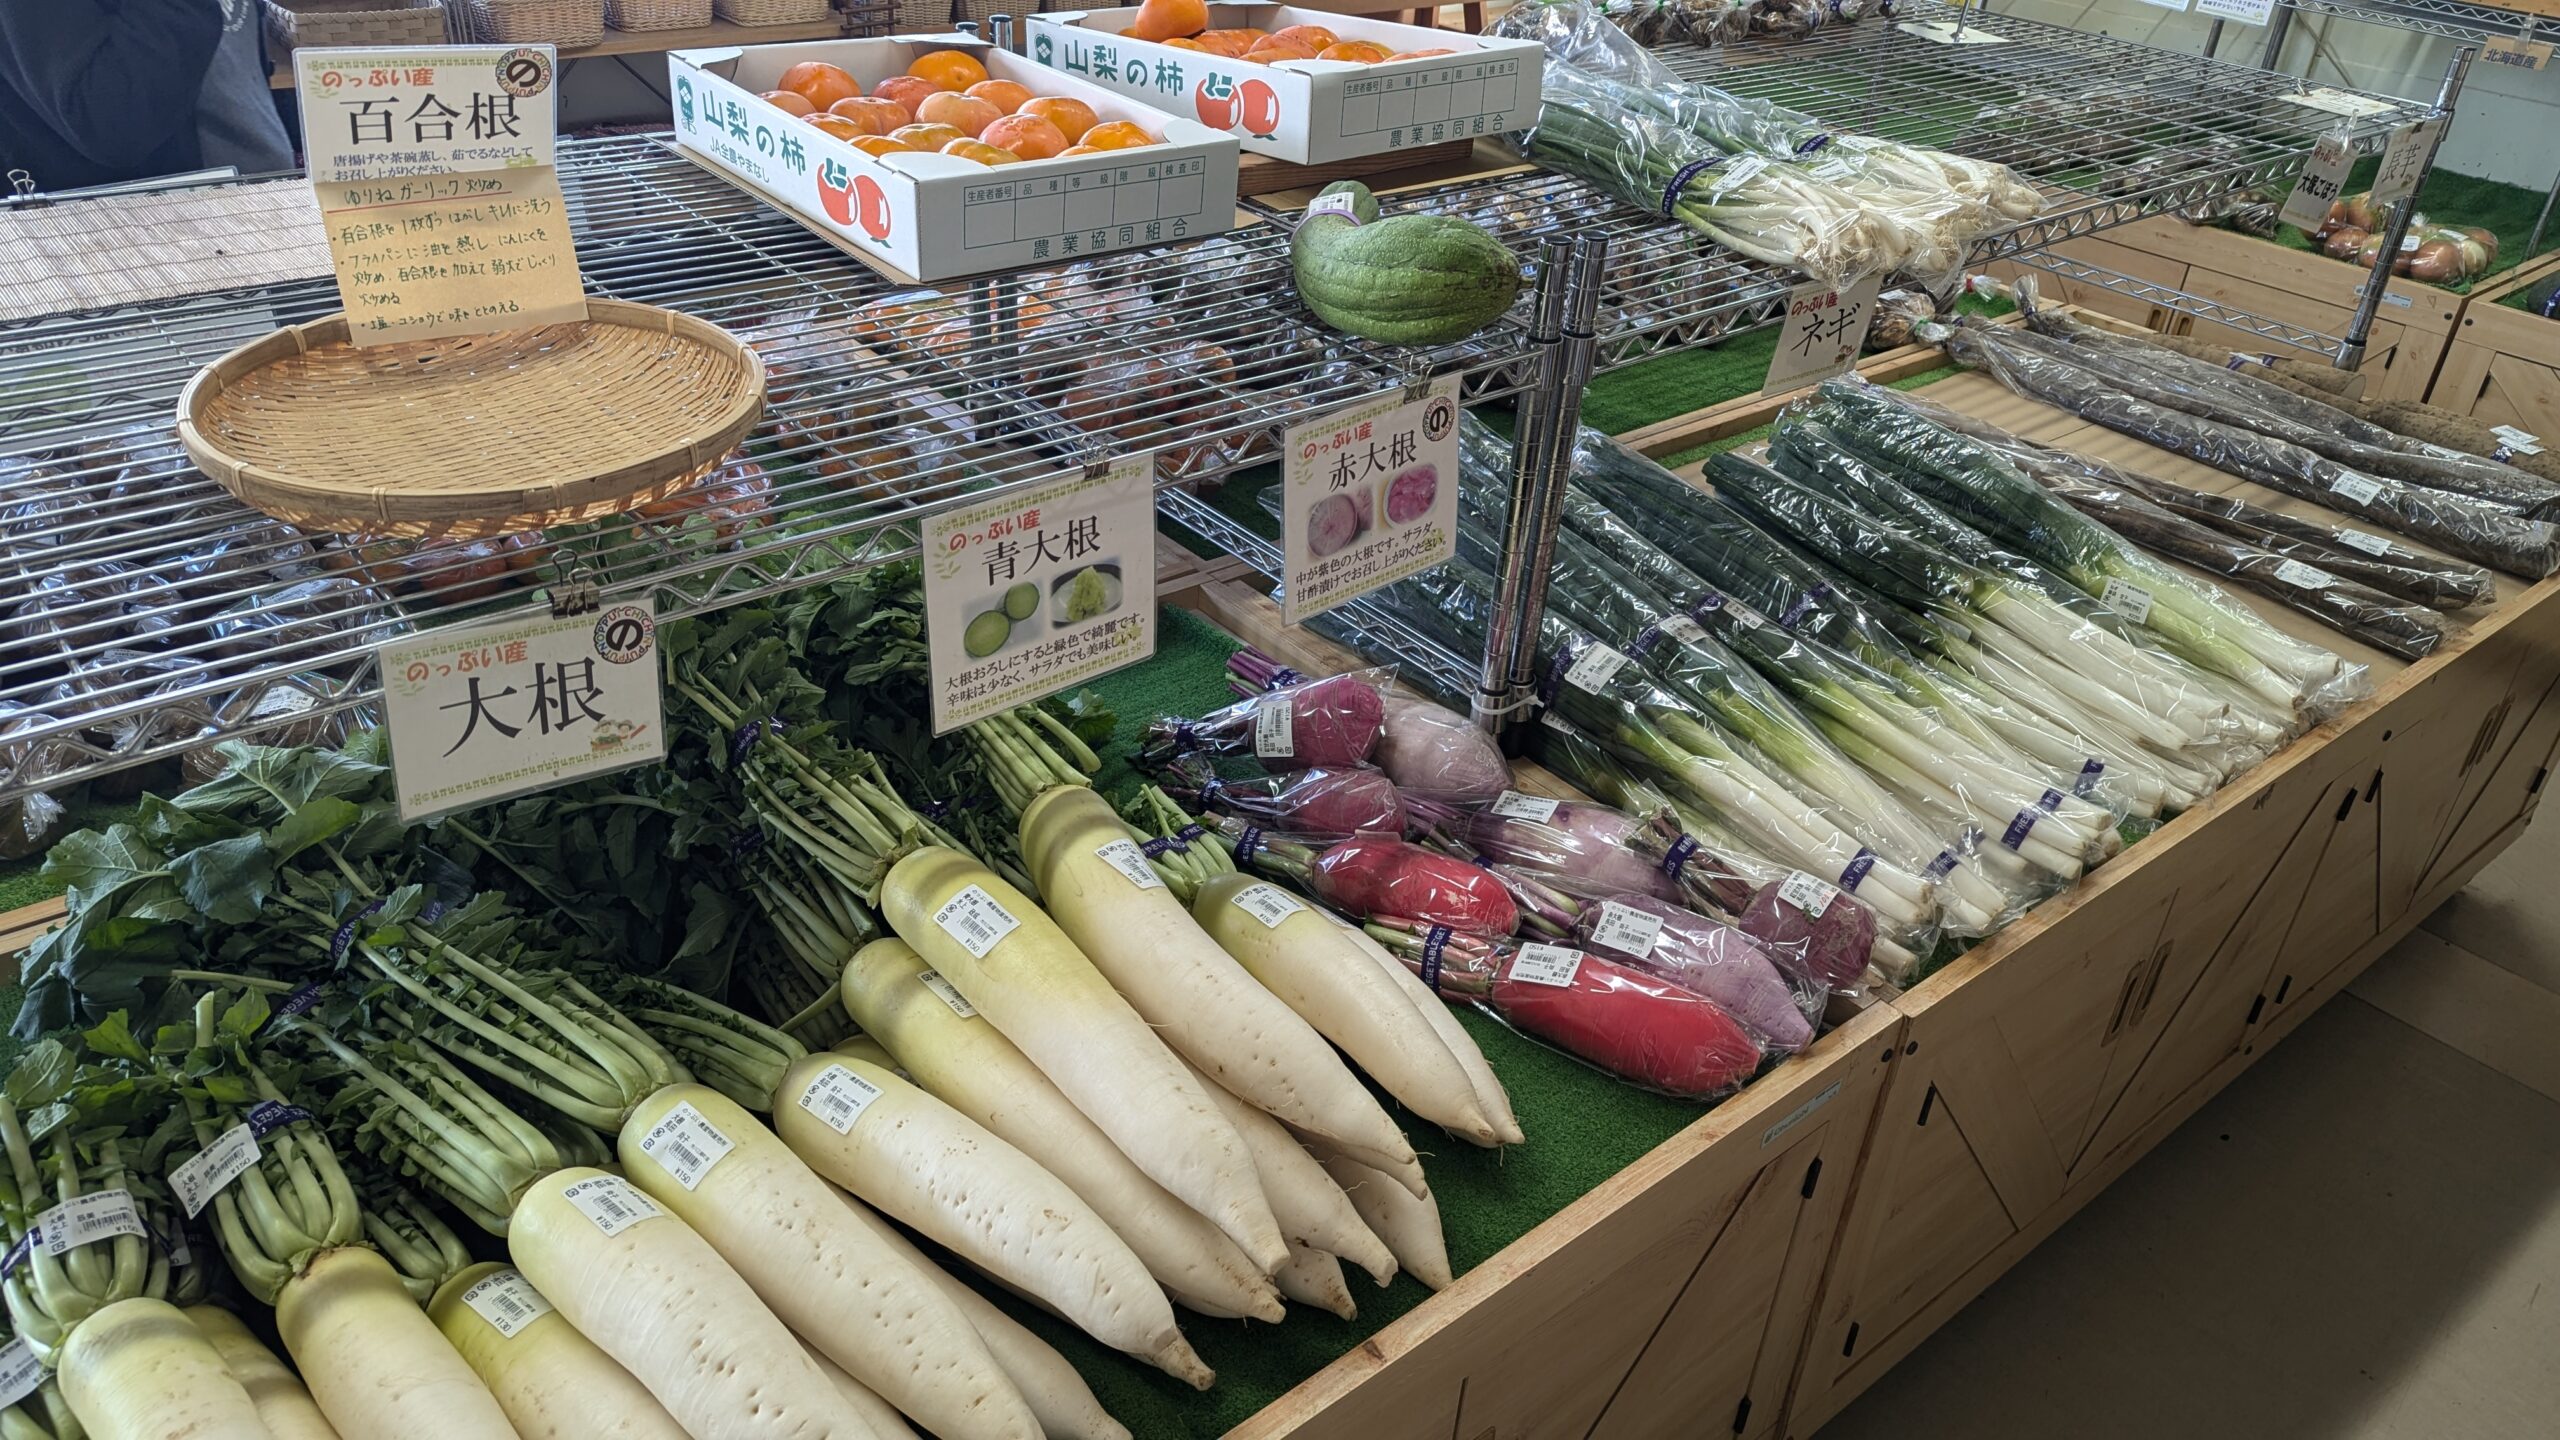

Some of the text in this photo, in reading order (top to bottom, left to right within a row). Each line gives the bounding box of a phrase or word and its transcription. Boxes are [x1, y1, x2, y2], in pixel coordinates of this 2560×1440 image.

[321, 67, 434, 88] のっぷい産
[1064, 40, 1184, 97] 山梨の柿
[2484, 48, 2538, 69] 北海道産
[339, 92, 521, 145] 百合根
[702, 90, 806, 176] 山梨の柿
[1389, 113, 1504, 148] 農業協同組合
[709, 138, 770, 183] JA全農やまなし
[967, 160, 1200, 202] 生産者番号 品種 等級 階級 検査印
[2297, 171, 2338, 202] 大塚ごぼう
[1033, 218, 1188, 260] 農業協同組合
[1791, 291, 1839, 316] のっぷい産
[1790, 302, 1861, 357] ネギ
[1304, 422, 1373, 459] のっぷい産
[1329, 429, 1417, 493] 赤大根
[950, 509, 1042, 551] のっぷい産
[982, 515, 1102, 586] 青大根
[1296, 521, 1437, 586] 中が紫色の大根です。サラダ、
[1296, 538, 1447, 603] 甘酢漬けでお召し上がりください。
[406, 640, 528, 682] のっぷい産
[946, 612, 1145, 692] 大根おろしにすると緑色で綺麗です。
[946, 631, 1137, 707] 辛味は少なく、サラダでも美味しい。
[439, 656, 606, 758] 大根
[964, 938, 980, 952] ¥150
[826, 1072, 837, 1081] 大根
[672, 1113, 684, 1125] 大根
[830, 1117, 845, 1129] ¥150
[230, 1157, 252, 1175] ¥150
[674, 1168, 691, 1183] ¥150
[596, 1215, 613, 1231] ¥150
[494, 1316, 512, 1332] ¥130
